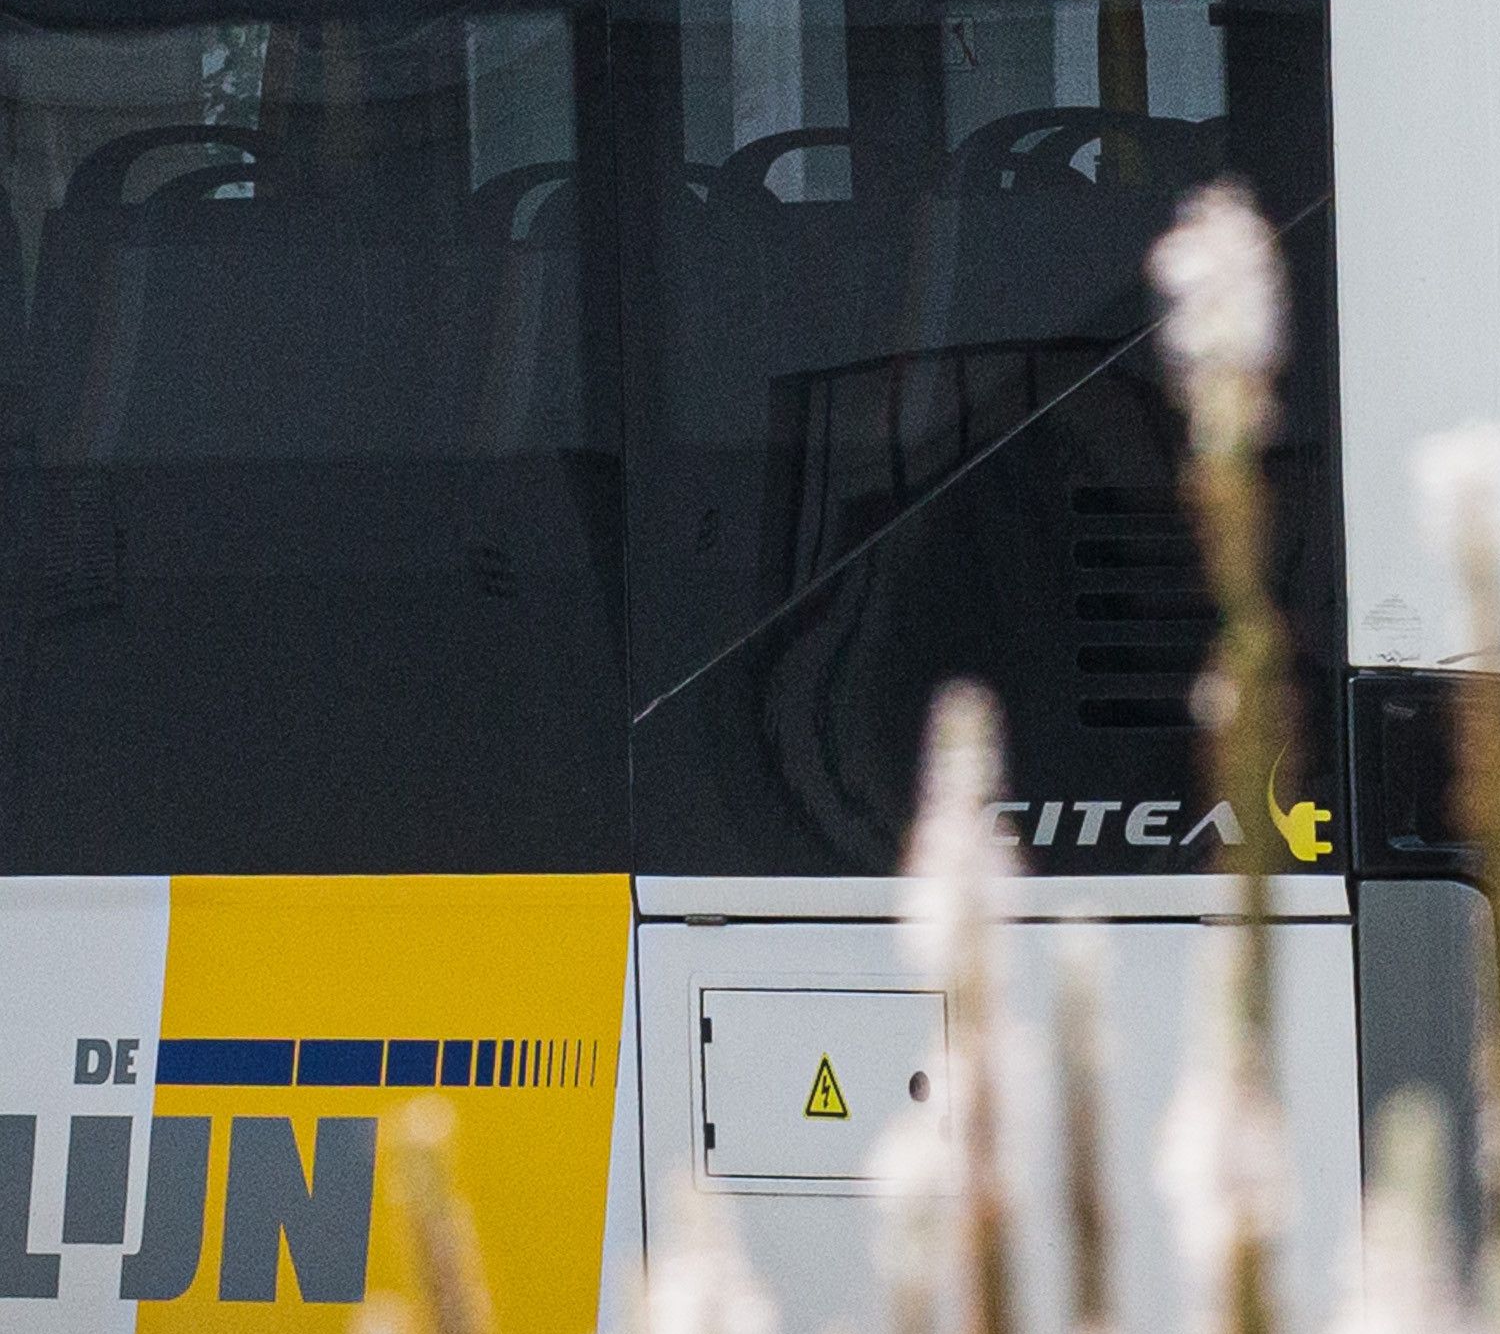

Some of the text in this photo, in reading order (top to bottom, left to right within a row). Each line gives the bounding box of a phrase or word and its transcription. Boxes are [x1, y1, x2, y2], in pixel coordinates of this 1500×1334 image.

[983, 800, 1246, 847] CITEA
[73, 1038, 140, 1086] DE
[0, 1115, 379, 1304] LIJN
